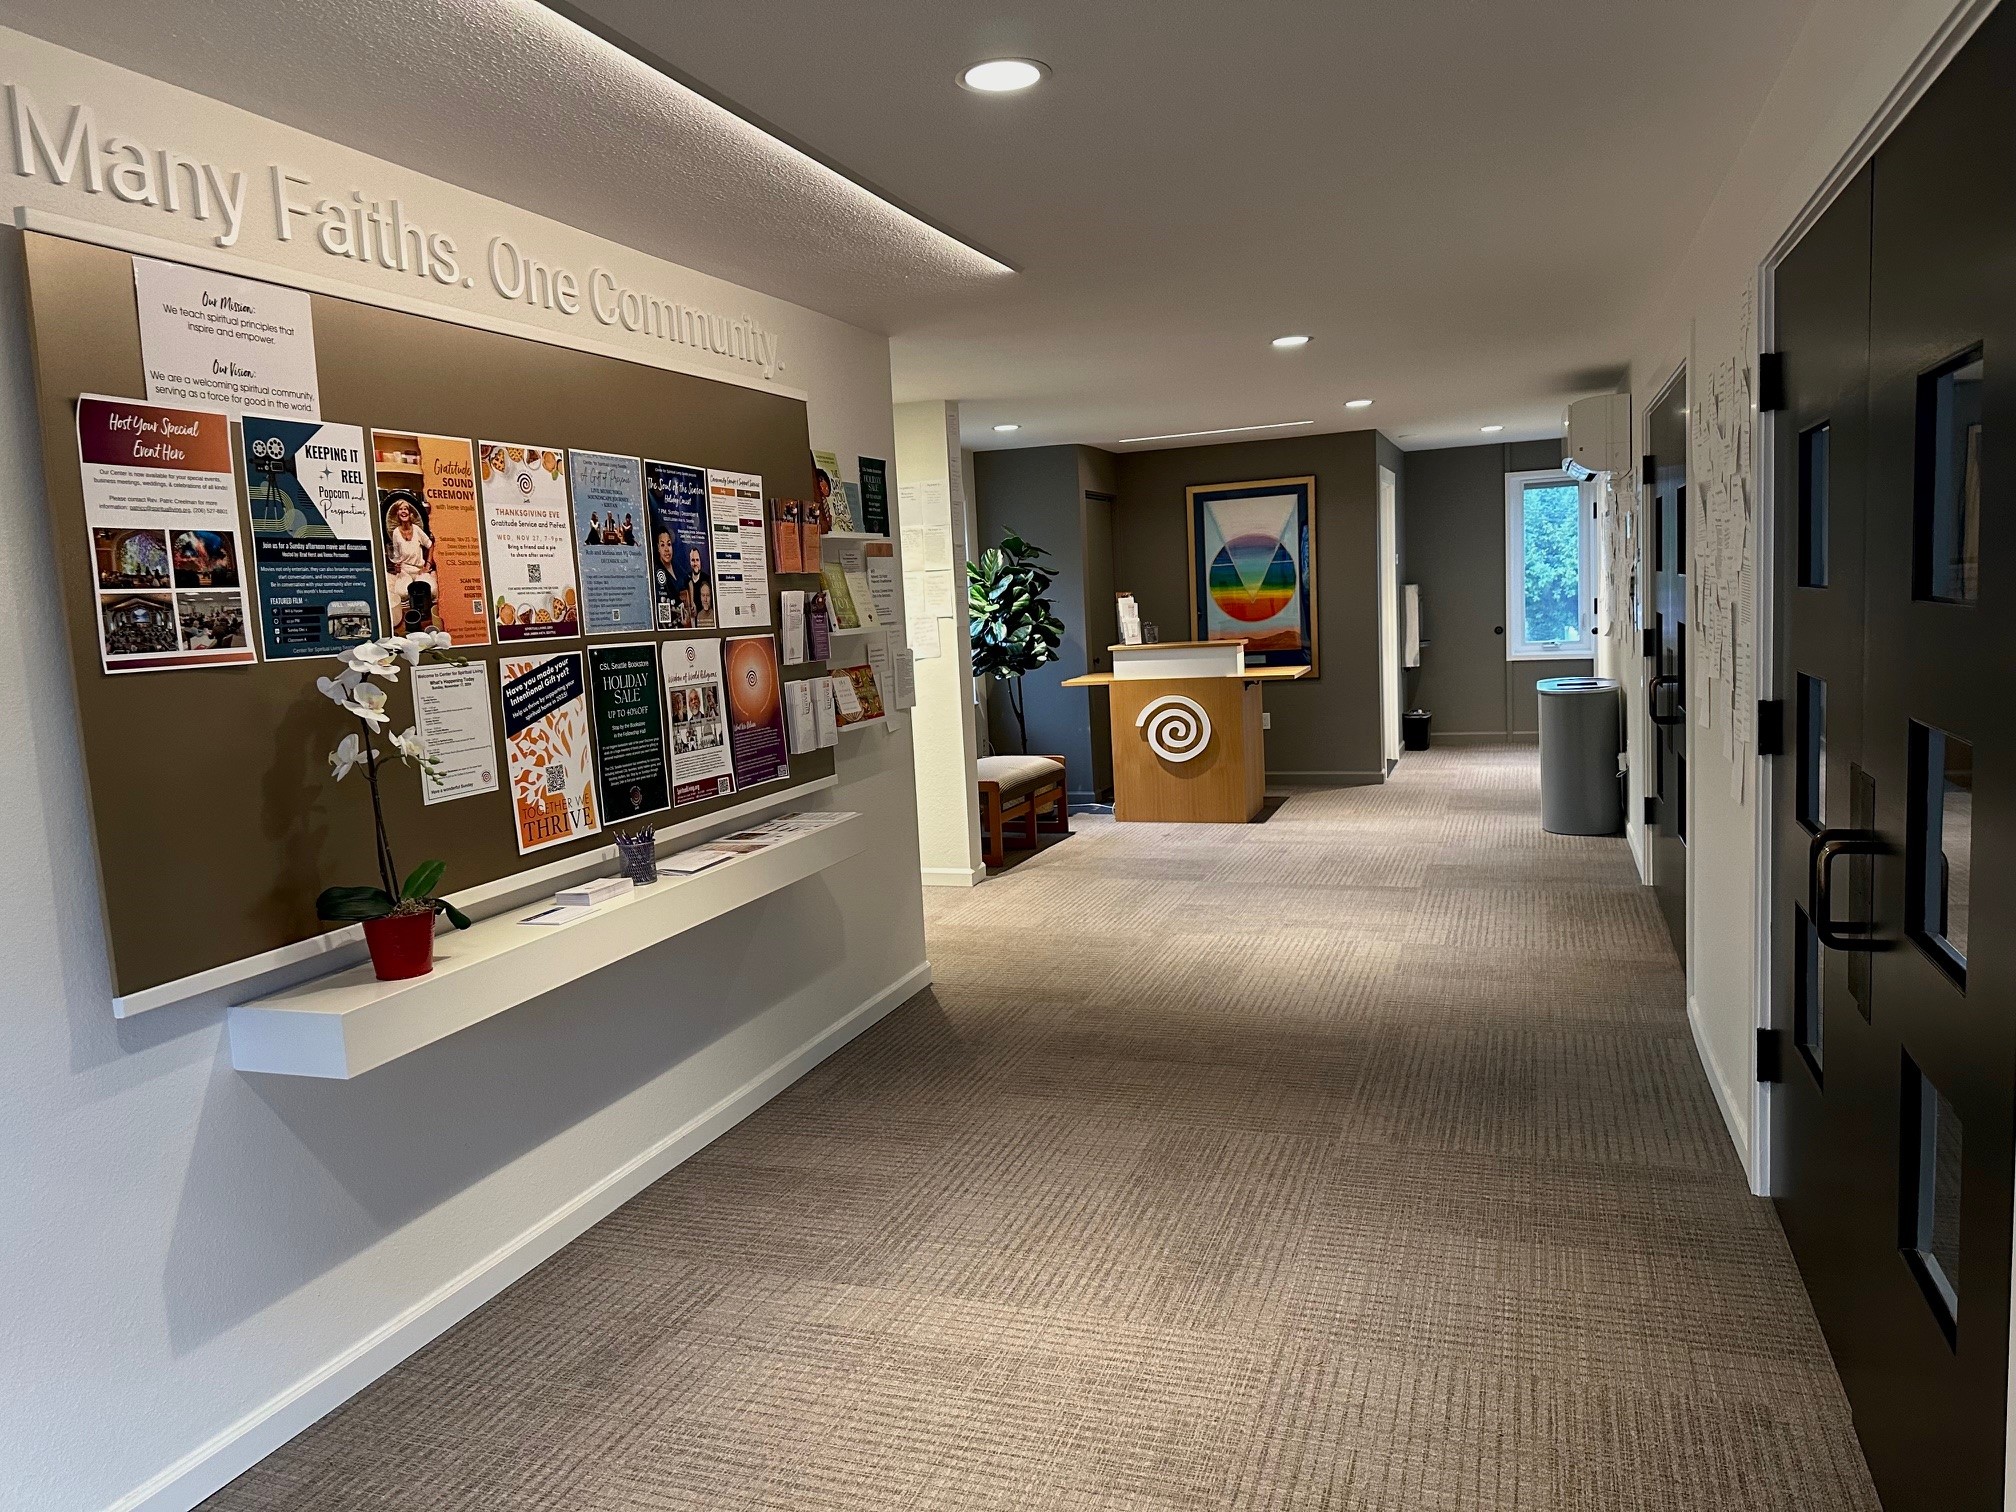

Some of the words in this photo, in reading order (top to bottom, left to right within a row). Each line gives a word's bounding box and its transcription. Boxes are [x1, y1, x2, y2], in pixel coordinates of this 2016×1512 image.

[5, 84, 248, 247] Many
[269, 165, 474, 288] Faiths.
[489, 235, 580, 315] One
[589, 267, 786, 379] Community.
[202, 291, 217, 307] Our
[221, 297, 256, 314] Mission:
[163, 304, 178, 314] We
[180, 308, 205, 320] teach
[207, 312, 238, 326] spiritual
[241, 320, 278, 333] principles
[279, 326, 294, 336] that
[188, 323, 214, 334] inspire
[216, 327, 234, 338] and
[236, 331, 276, 344] empower.
[213, 359, 228, 374] Our
[230, 362, 257, 378] Vision:
[150, 371, 165, 381] We
[168, 374, 182, 383] are
[193, 378, 238, 392] welcoming
[240, 383, 269, 394] spiritual
[155, 386, 186, 398] serving
[189, 390, 198, 398] as
[207, 392, 229, 402] force
[231, 395, 242, 404] for
[244, 397, 266, 406] good
[276, 401, 289, 409] the
[291, 403, 313, 412] world.
[110, 413, 132, 431] Host
[133, 416, 158, 435] Your
[161, 417, 199, 438] Special
[134, 440, 160, 458] Event
[163, 443, 185, 461] Here
[305, 445, 347, 462] KEEPING
[350, 450, 358, 463] IT
[341, 470, 363, 484] REEL
[434, 458, 471, 477] Gratitude
[443, 478, 473, 488] SOUND
[647, 477, 657, 489] The
[658, 479, 671, 491] Soul
[672, 480, 678, 495] of
[679, 482, 687, 493] the
[319, 486, 350, 499] Popcorn
[351, 488, 365, 501] and
[427, 489, 474, 500] CEREMONY
[496, 508, 546, 517] THANKSGIVING
[491, 519, 517, 527] Gratitude
[290, 542, 305, 550] Sunday
[506, 683, 523, 697] Have
[524, 676, 536, 689] you
[537, 666, 554, 680] made
[555, 658, 568, 672] your
[510, 681, 544, 706] Intentional
[545, 676, 555, 686] Gift
[556, 667, 569, 682] yet?
[603, 673, 648, 690] HOLIDAY
[512, 710, 523, 719] Help
[528, 699, 539, 709] thrive
[539, 695, 545, 703] by
[545, 683, 566, 700] supporting
[566, 679, 575, 688] your
[614, 688, 640, 704] SALE
[526, 705, 541, 721] spiritual
[541, 702, 552, 710] home
[608, 710, 617, 719] UP
[617, 709, 625, 717] TO
[444, 784, 460, 792] wonderful
[523, 798, 573, 819] TOGETHER
[575, 793, 589, 805] WE
[524, 807, 593, 841] THRIVE
